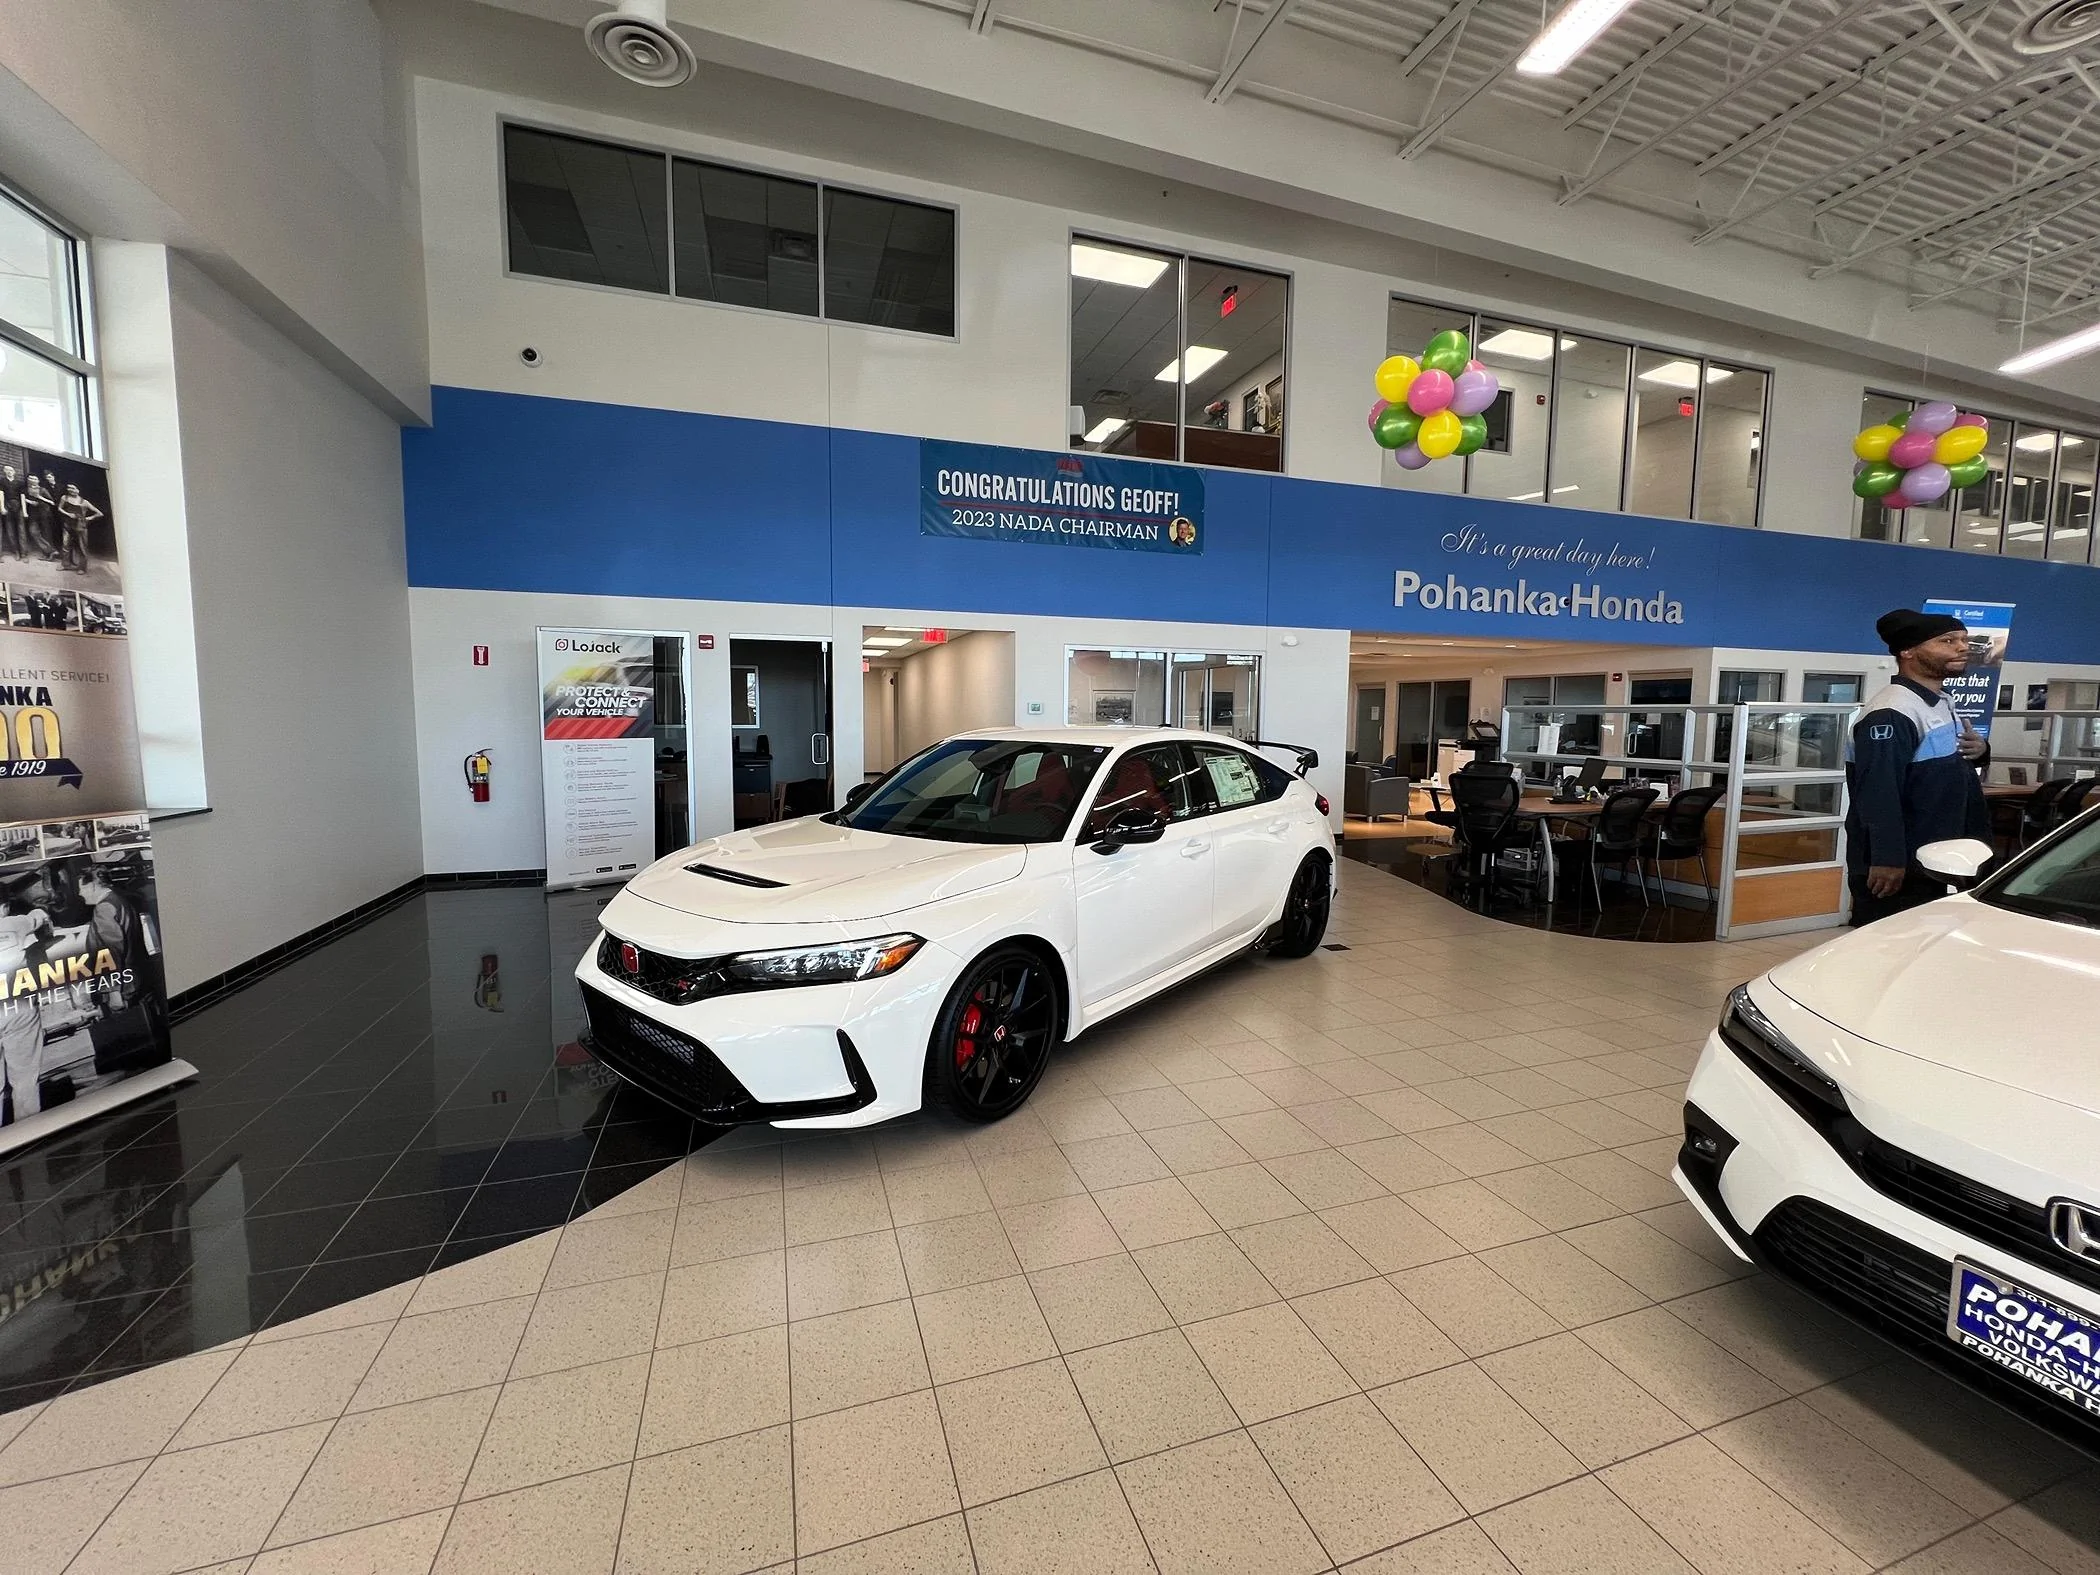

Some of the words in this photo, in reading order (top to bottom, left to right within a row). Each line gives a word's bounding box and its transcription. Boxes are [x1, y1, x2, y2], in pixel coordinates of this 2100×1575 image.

[938, 469, 1115, 510] CONGRATULATIONS
[1121, 487, 1179, 516] GEOFF!
[952, 509, 995, 527] 2023
[1000, 513, 1053, 532] NADA
[1059, 518, 1158, 540] CHAIRMAN
[1440, 523, 1487, 555] It's
[1493, 543, 1506, 557] a
[1507, 541, 1566, 570] great
[1565, 538, 1602, 577] day
[1605, 543, 1656, 570] here!
[1394, 570, 1560, 617] Pohanka
[1570, 583, 1685, 624] Honda
[0, 669, 46, 680] LLENT
[51, 670, 110, 683] SERVICE!
[1968, 673, 1990, 687] that
[0, 686, 53, 706] NKA
[555, 686, 621, 697] PROTECT
[575, 697, 645, 708] CONNECT
[1964, 693, 1986, 706] you
[556, 708, 584, 716] YOUR
[586, 708, 624, 716] VEHICLE
[0, 707, 62, 760] 0
[11, 761, 46, 776] 1919
[25, 986, 66, 1010] THE
[71, 968, 134, 997] YEARS
[1967, 1283, 2100, 1363] POHA
[1963, 1335, 2075, 1400] POHANKA
